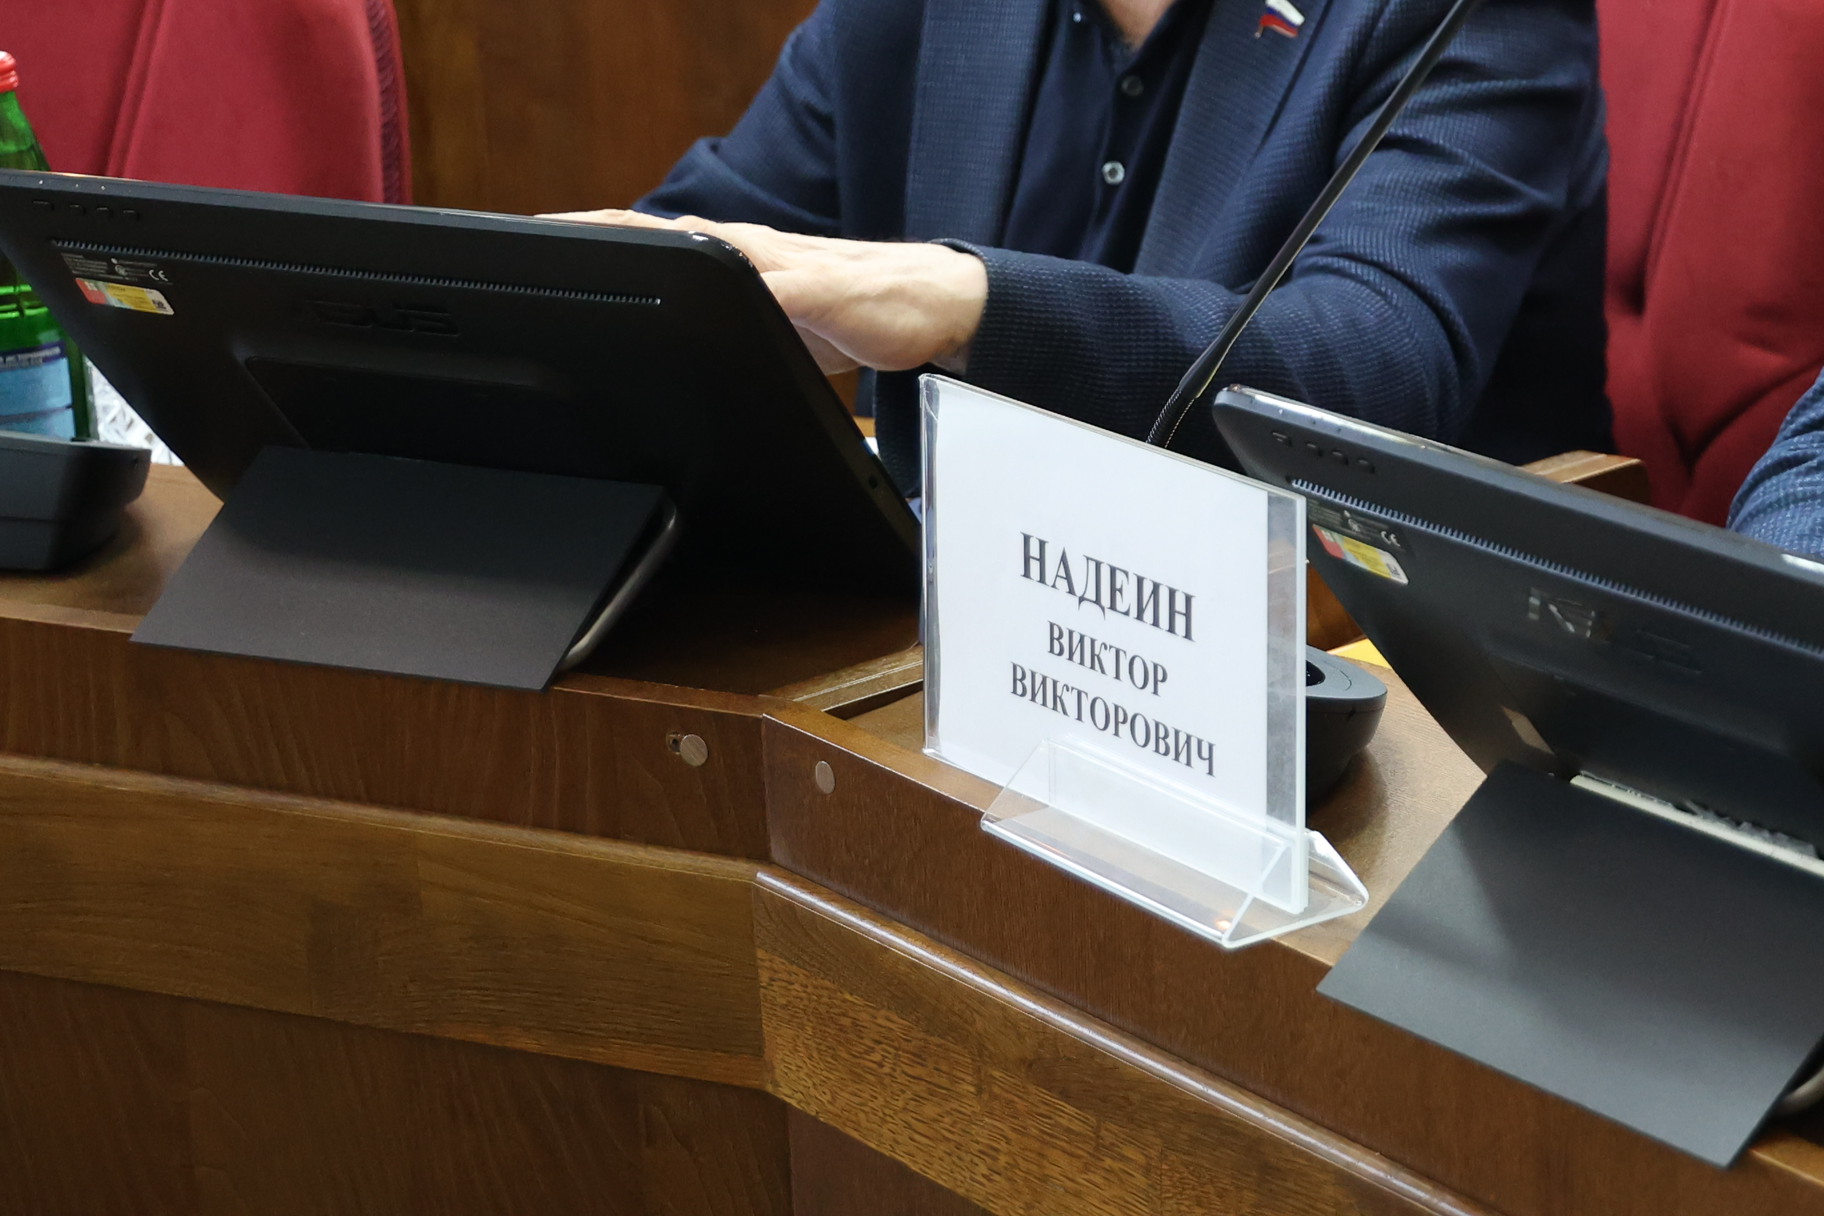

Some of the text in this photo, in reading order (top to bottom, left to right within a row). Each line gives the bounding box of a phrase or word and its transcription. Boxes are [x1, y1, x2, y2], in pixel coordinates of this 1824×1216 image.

[1020, 531, 1196, 643] НАДЕИН
[1048, 620, 1169, 698] ВИКТОР
[1010, 660, 1217, 779] ВИКТОРОВИЧ
